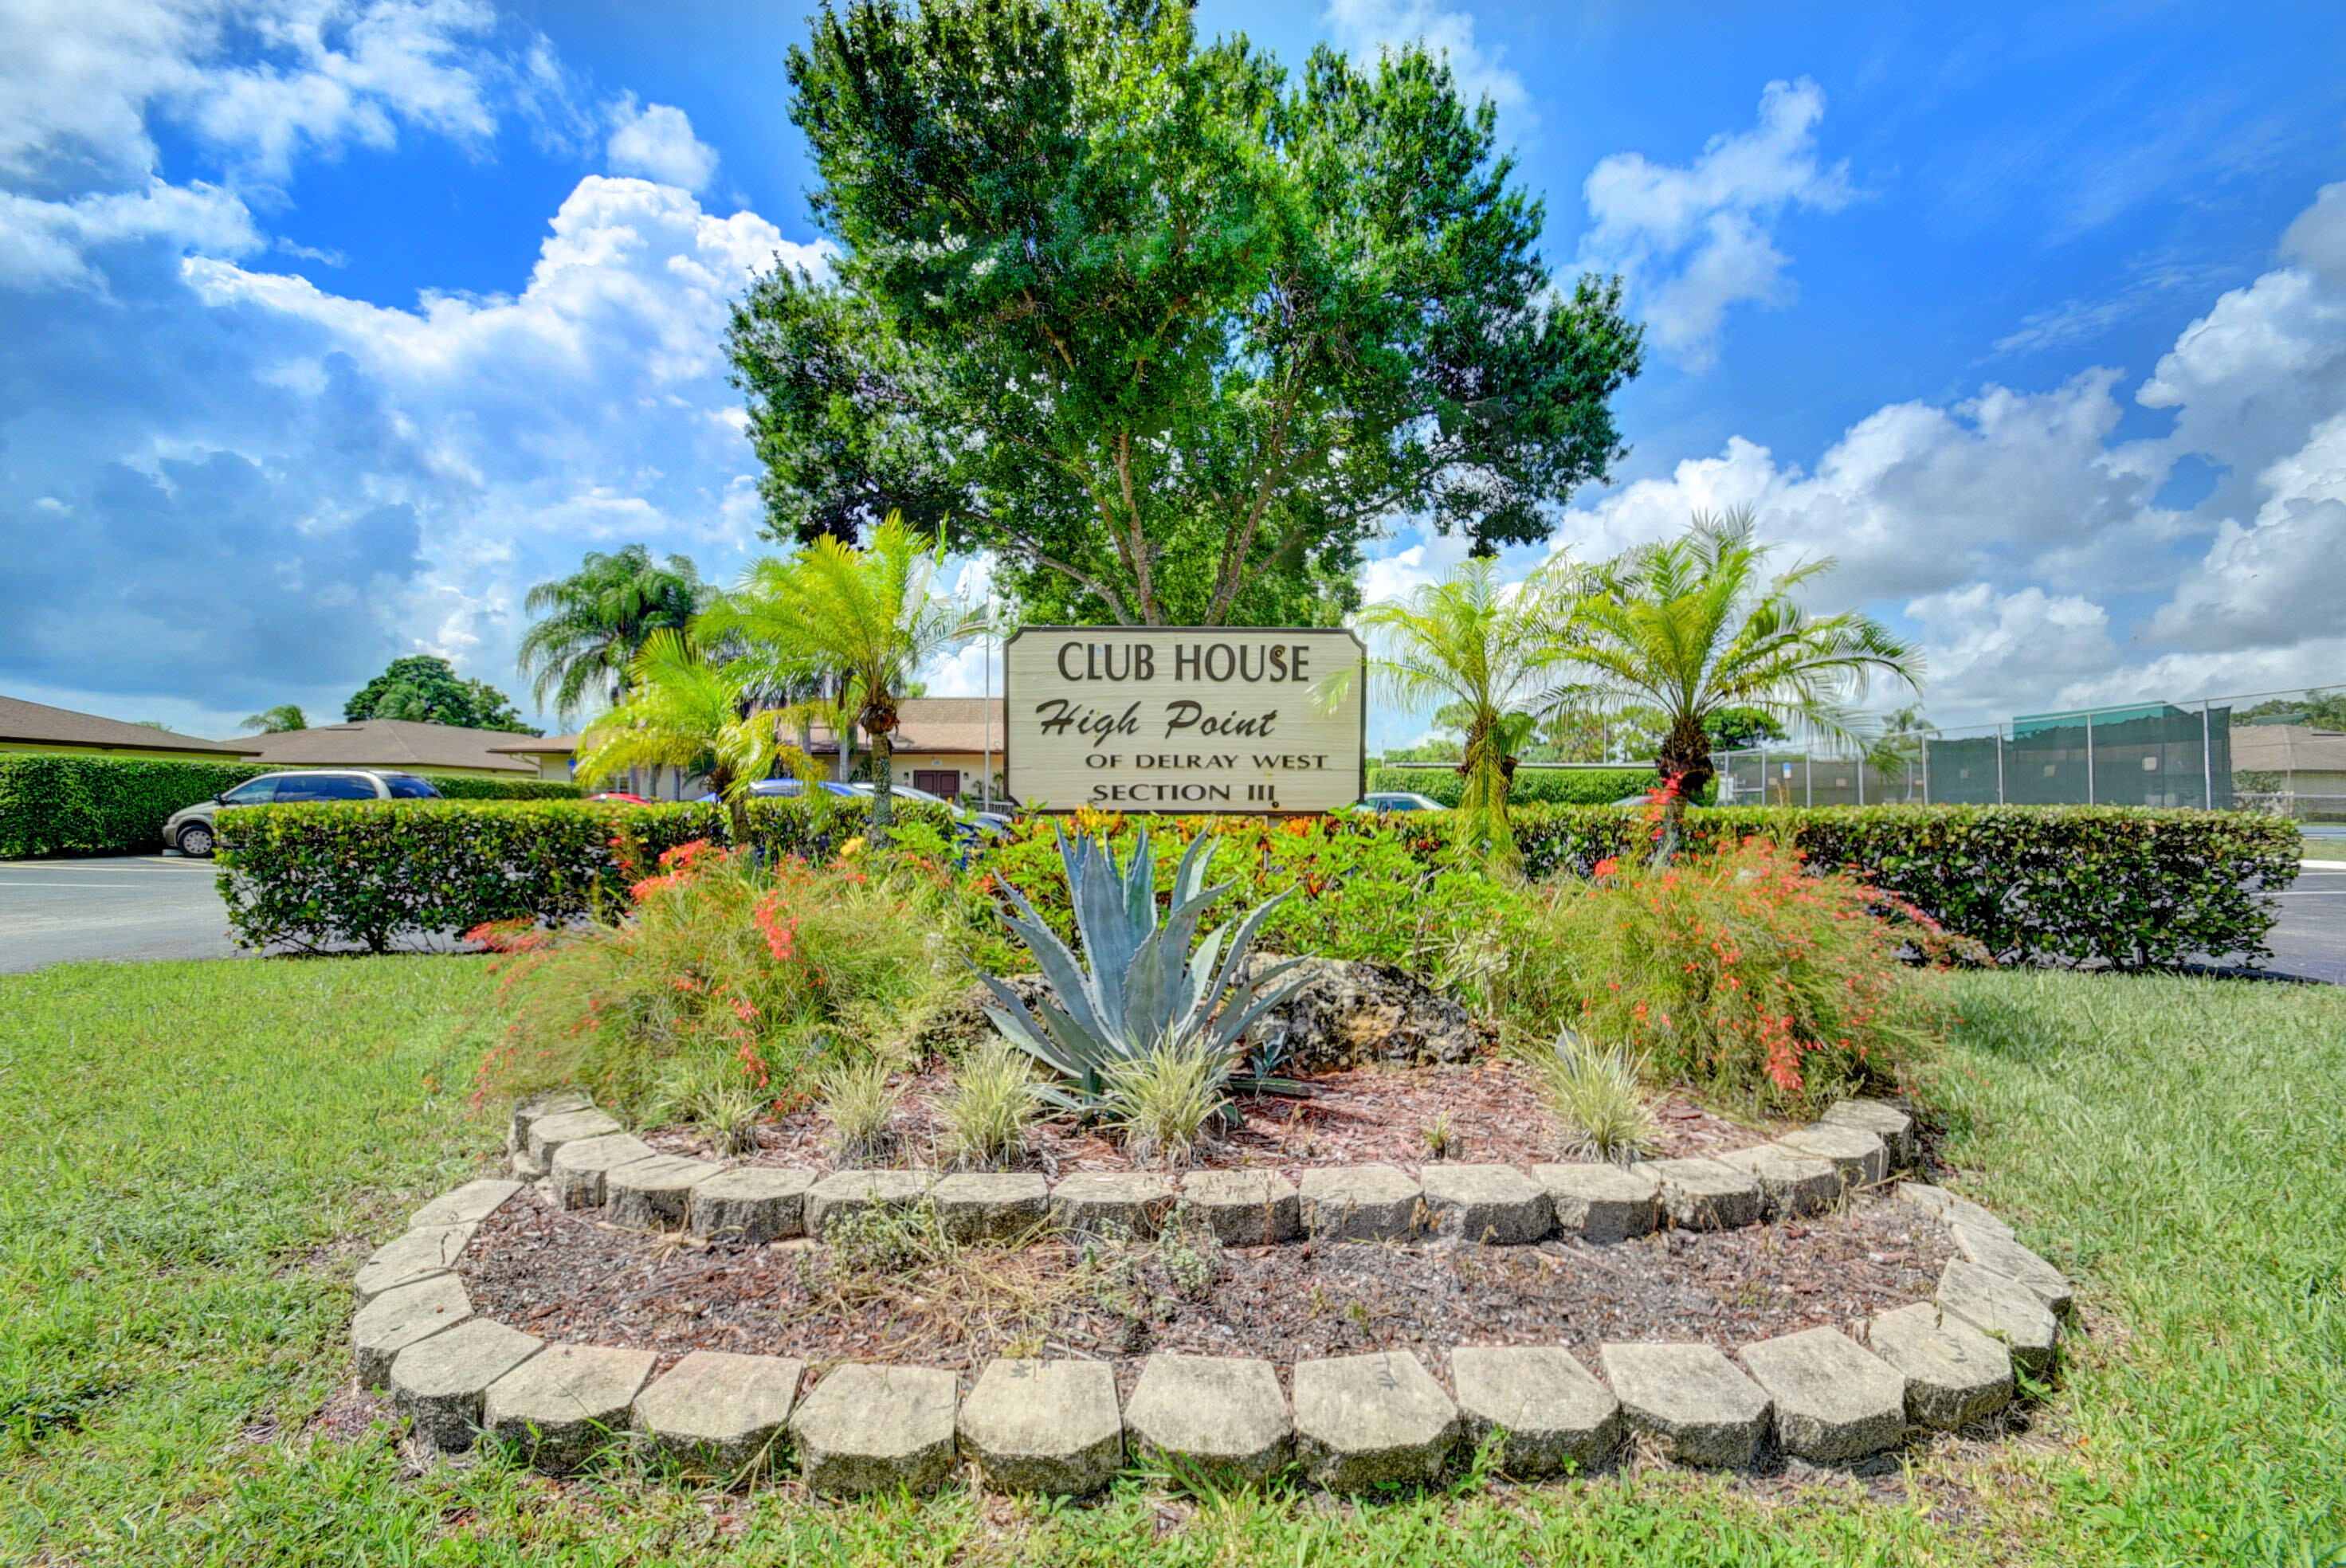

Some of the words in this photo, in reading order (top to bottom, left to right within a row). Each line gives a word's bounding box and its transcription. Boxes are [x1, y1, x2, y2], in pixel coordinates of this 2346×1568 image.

[1057, 641, 1155, 681] CLUB
[1175, 643, 1308, 682] HOUSE
[1036, 698, 1142, 747] High
[1165, 700, 1277, 739] Point
[1085, 754, 1122, 769] OF
[1135, 754, 1238, 770] DELRAY
[1253, 755, 1328, 770] WEST
[1093, 784, 1230, 801] SECTION
